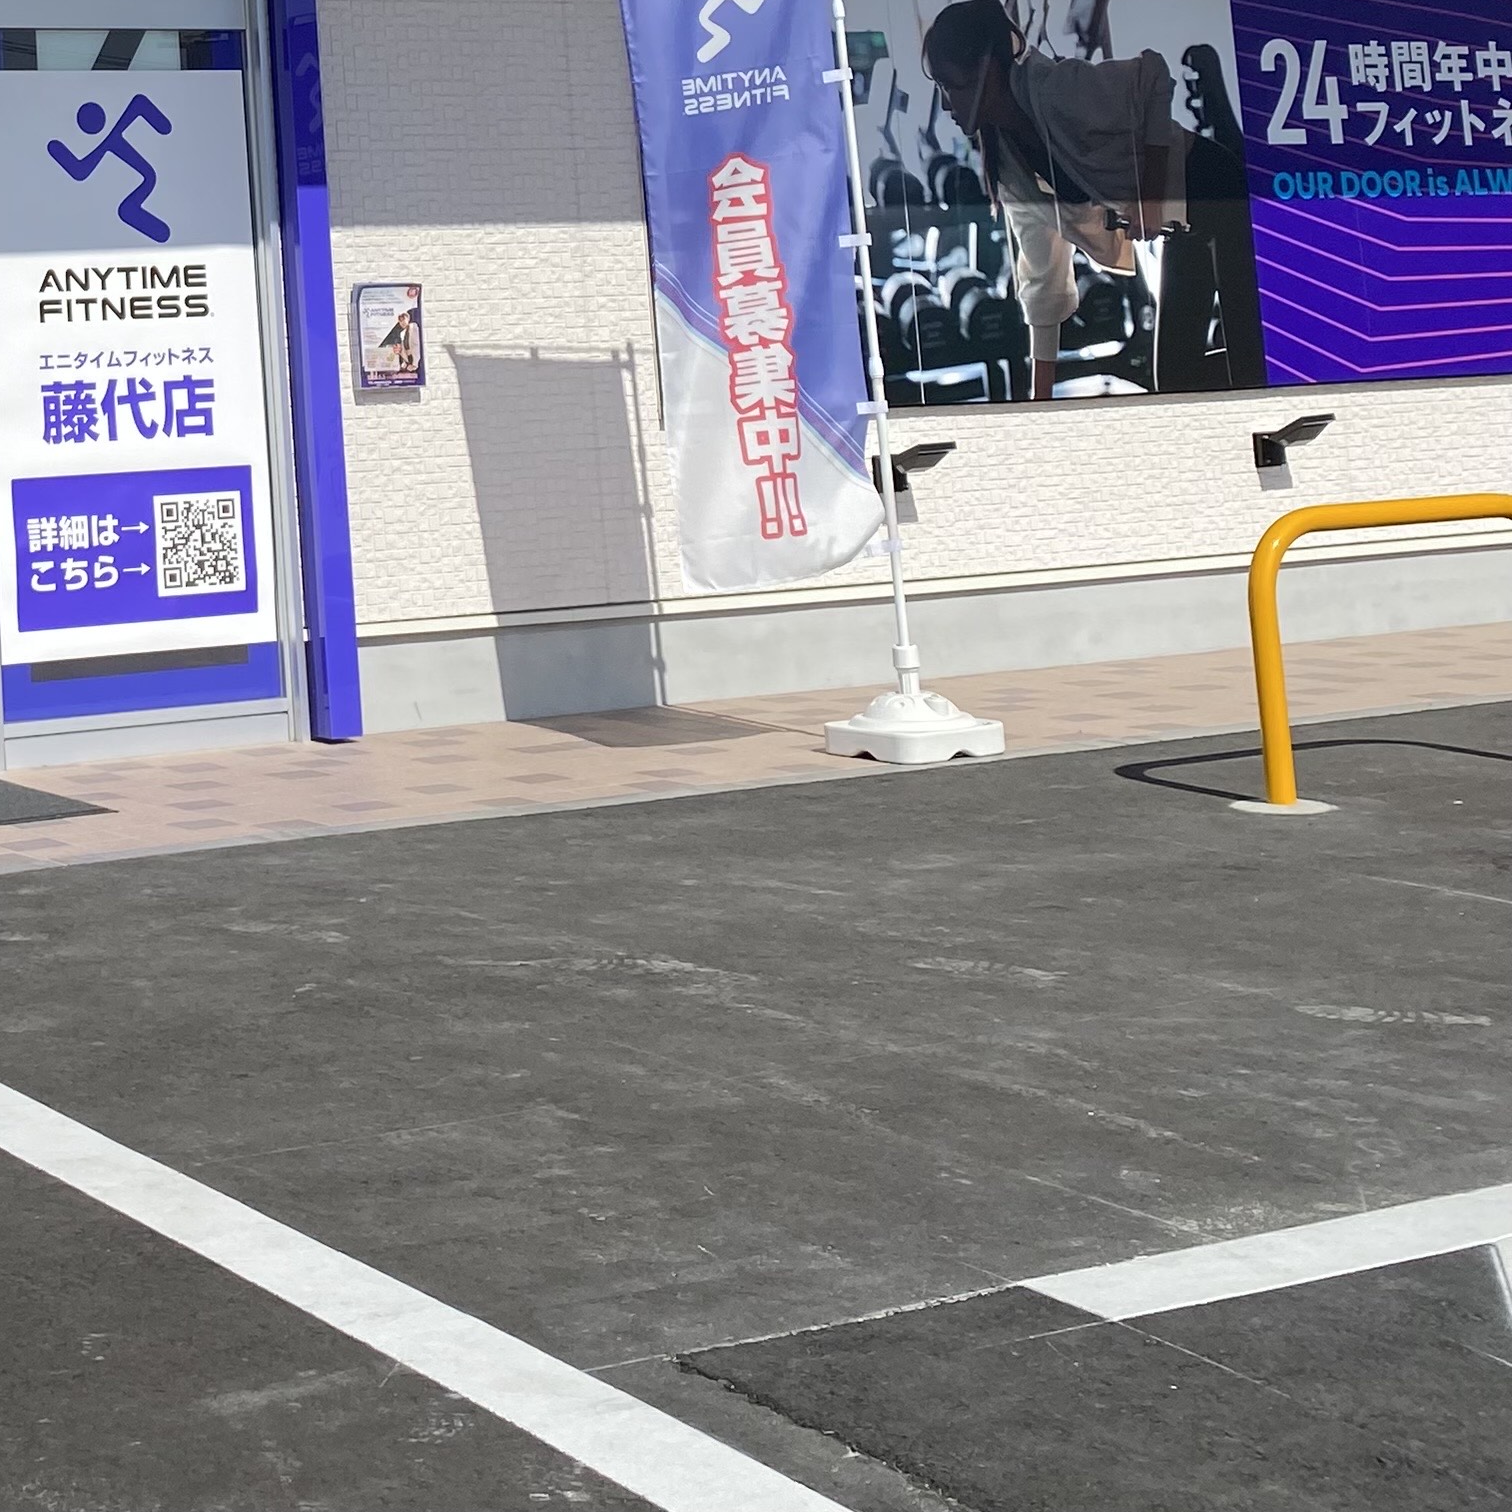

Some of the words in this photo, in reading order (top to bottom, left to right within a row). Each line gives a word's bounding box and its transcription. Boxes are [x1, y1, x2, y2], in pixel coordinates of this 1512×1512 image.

[1273, 171, 1335, 200] OUR
[1340, 170, 1422, 198] DOOR
[1427, 168, 1449, 196] is
[39, 264, 208, 293] ANYTIME
[39, 294, 211, 323] FITNESS
[40, 347, 214, 370] エニタイムフィットネス
[41, 375, 215, 444] 藤代店
[27, 514, 120, 553] 詳細は
[31, 555, 119, 592] こちら
